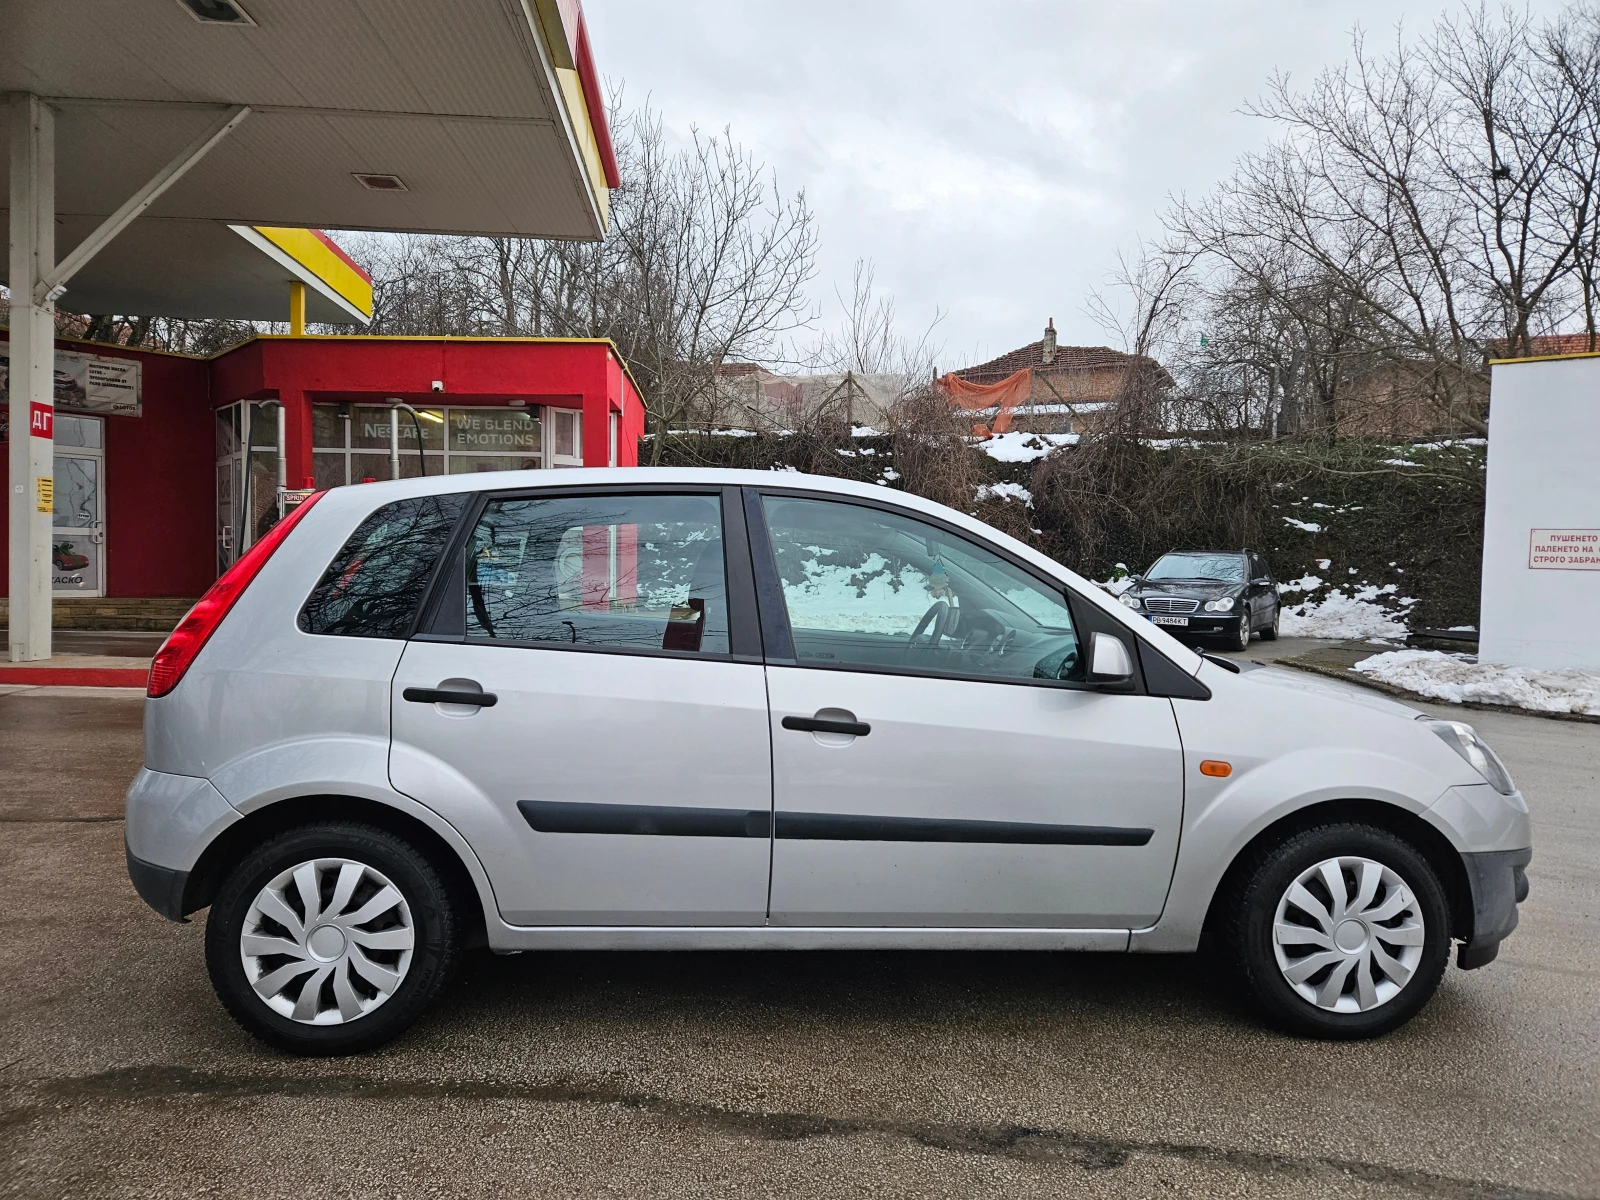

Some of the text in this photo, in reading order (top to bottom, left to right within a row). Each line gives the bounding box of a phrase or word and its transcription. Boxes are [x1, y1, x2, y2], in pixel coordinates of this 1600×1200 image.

[32, 410, 52, 430] ДГ
[456, 418, 534, 431] WE BLEND
[457, 434, 534, 445] EMOTIONS
